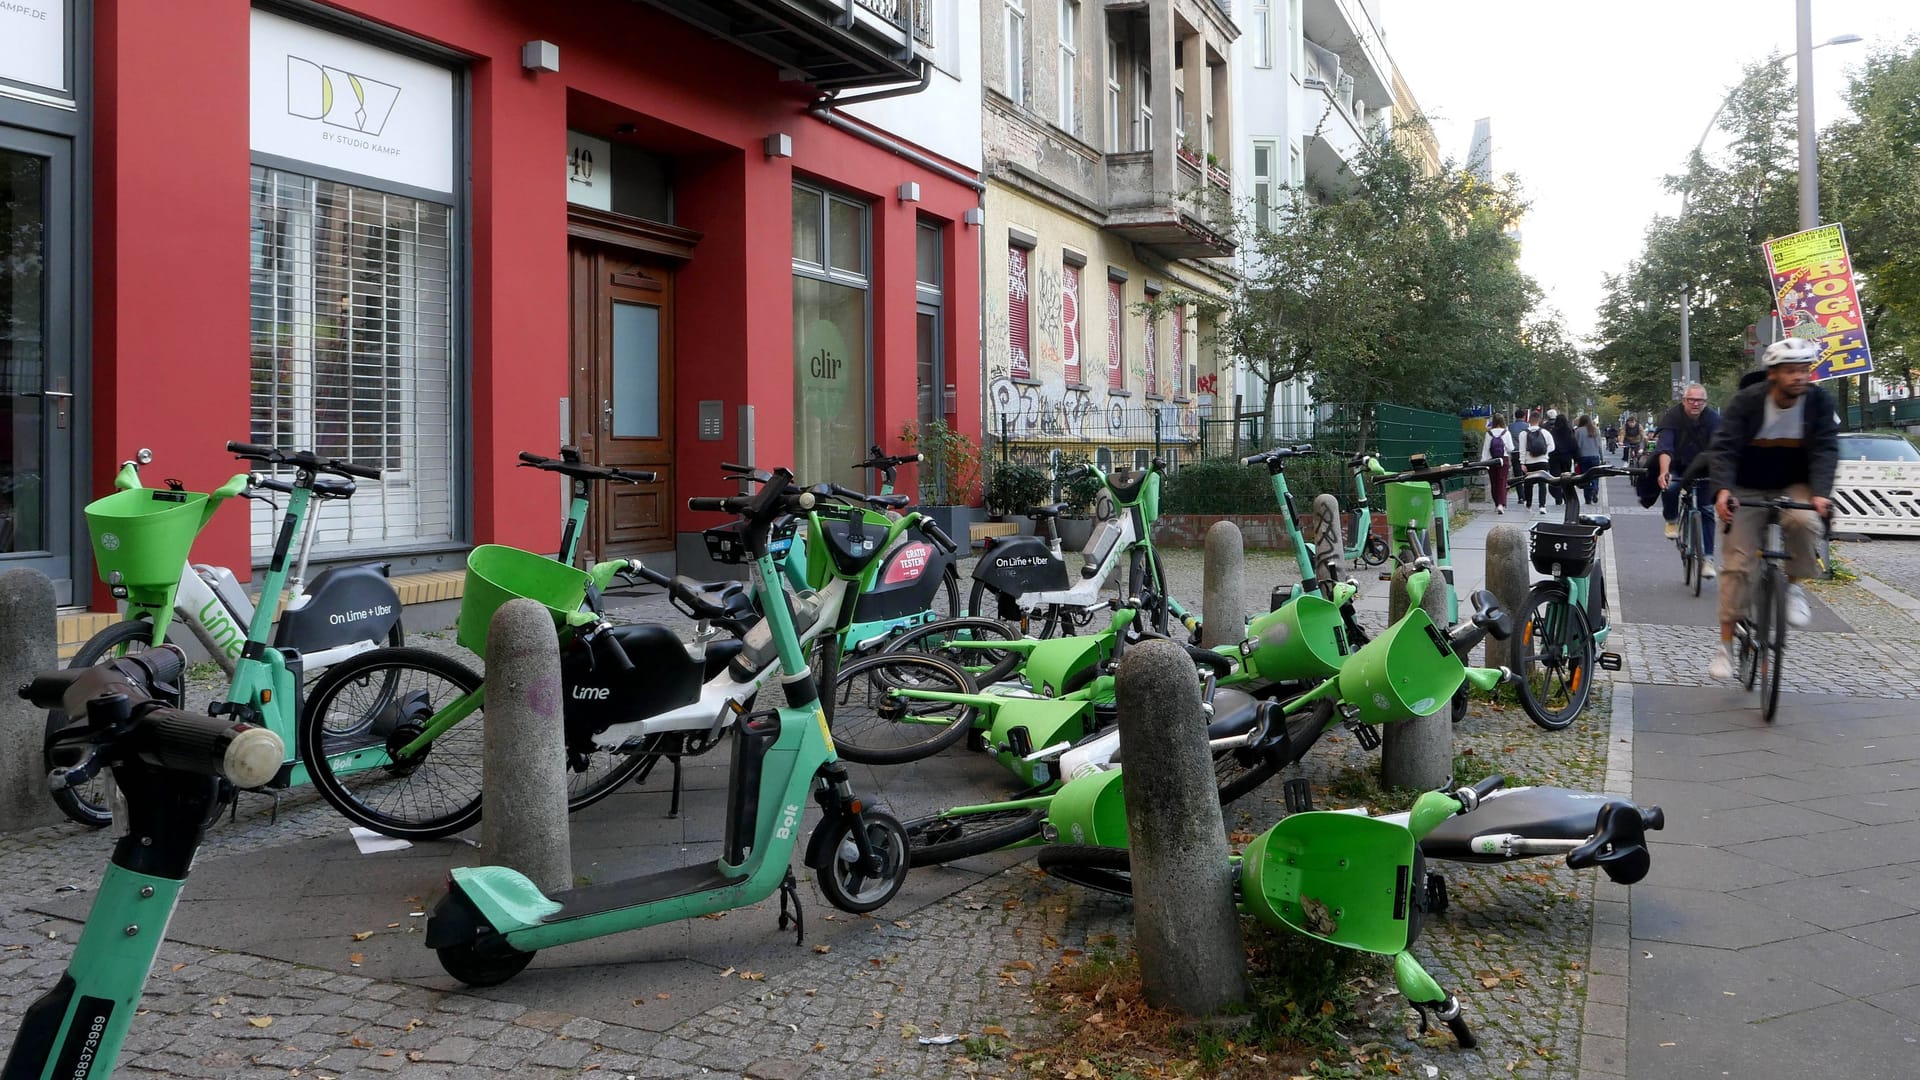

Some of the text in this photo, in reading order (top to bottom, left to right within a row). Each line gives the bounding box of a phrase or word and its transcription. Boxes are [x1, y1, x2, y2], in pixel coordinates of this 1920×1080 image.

[322, 131, 335, 141] BY
[371, 143, 401, 157] KAMPF
[568, 147, 593, 179] 40
[1777, 265, 1811, 298] CIRCUS
[811, 348, 842, 380] clir
[906, 549, 926, 559] GRATIS
[996, 558, 1009, 567] On
[1033, 556, 1048, 565] Uber
[199, 598, 245, 660] Lime
[330, 614, 346, 625] On
[346, 610, 368, 622] Lime
[374, 605, 392, 617] Uber
[776, 804, 799, 840] Bolt
